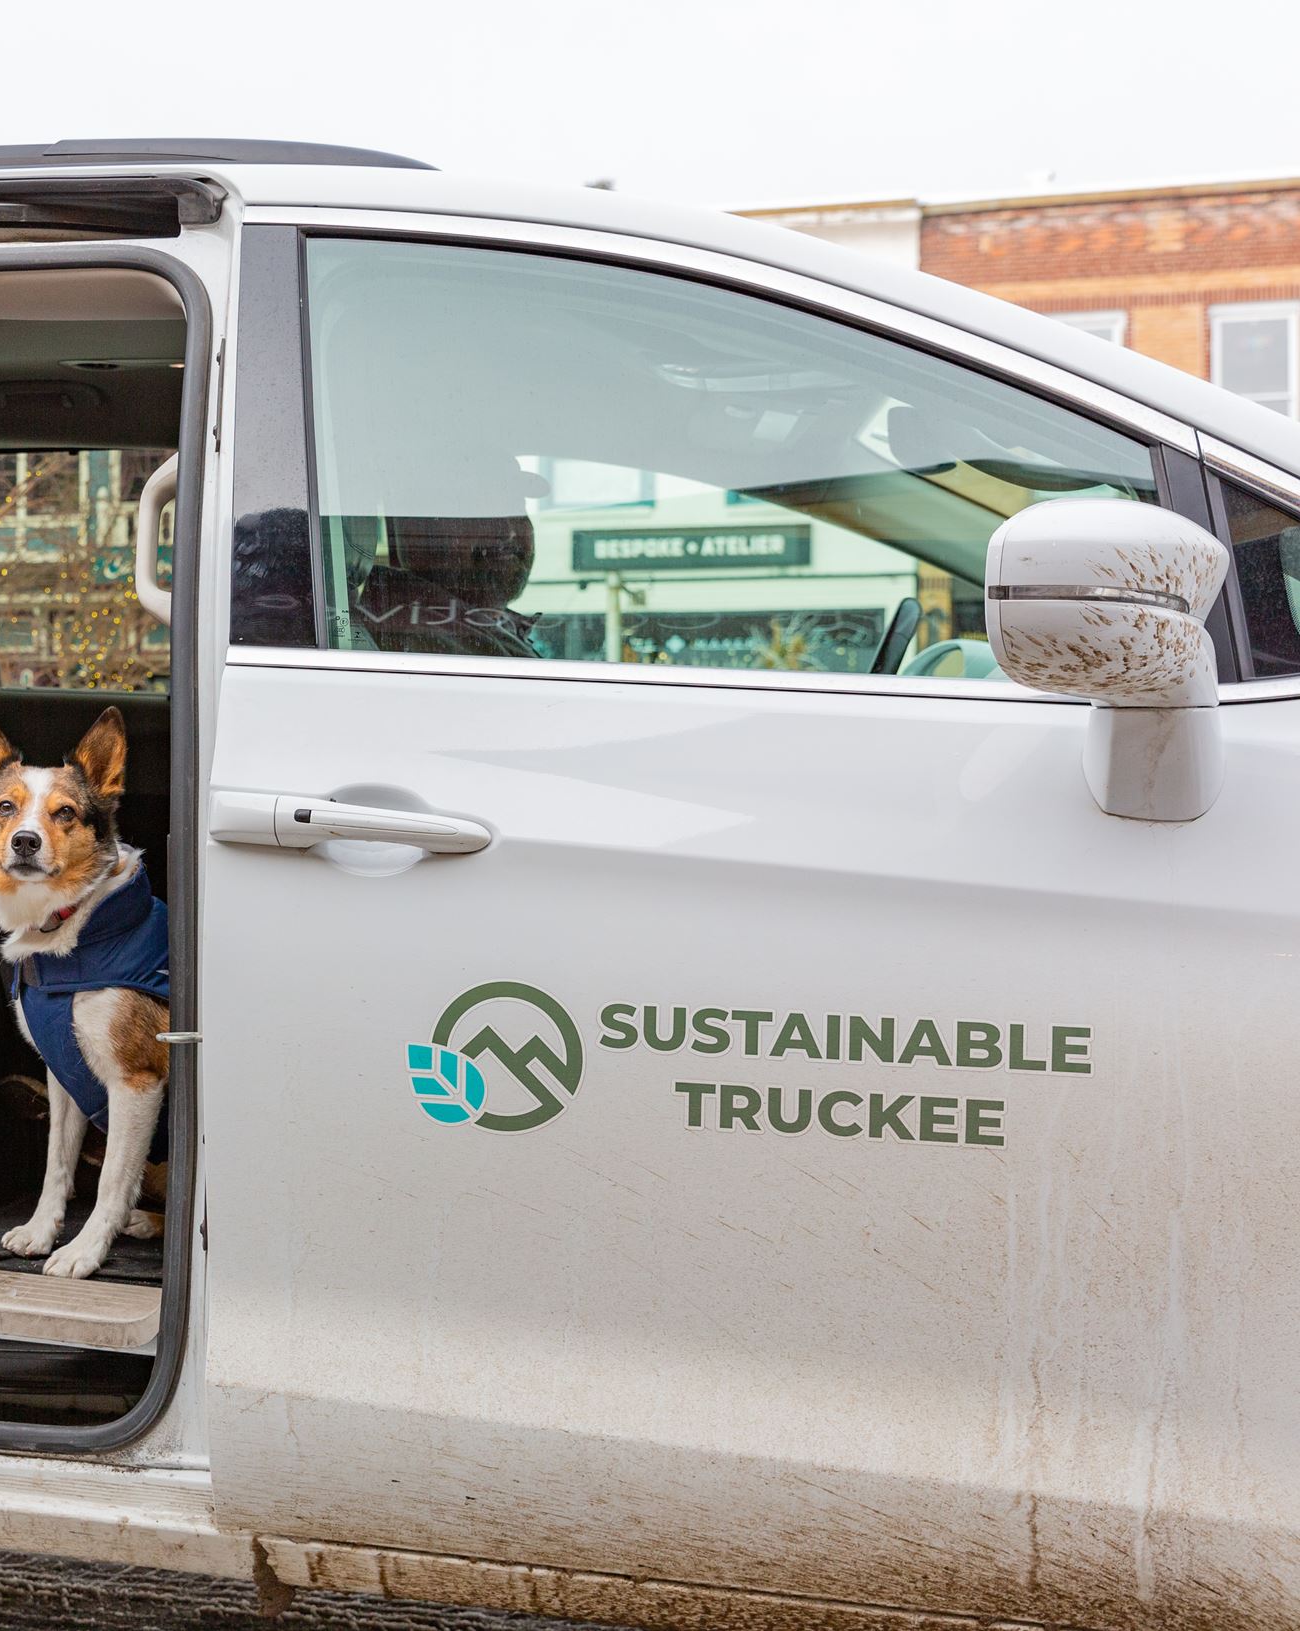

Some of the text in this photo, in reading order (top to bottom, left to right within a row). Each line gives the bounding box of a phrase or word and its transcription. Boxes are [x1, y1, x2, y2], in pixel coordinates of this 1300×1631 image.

[593, 534, 786, 559] BESPOKE ATELIER
[599, 1003, 1092, 1074] SUSTAINABLE
[674, 1081, 1005, 1147] TRUCKEE
